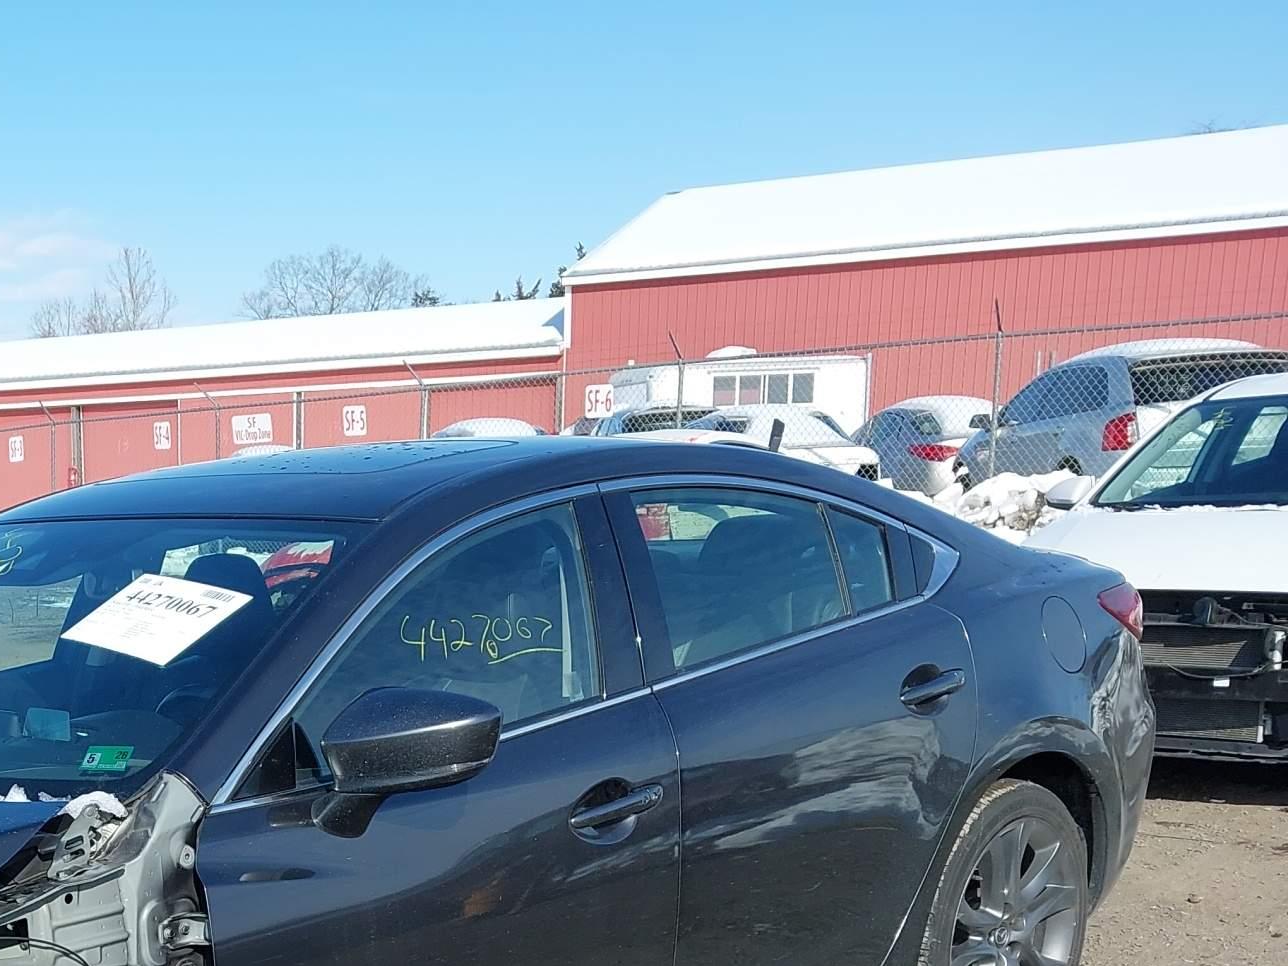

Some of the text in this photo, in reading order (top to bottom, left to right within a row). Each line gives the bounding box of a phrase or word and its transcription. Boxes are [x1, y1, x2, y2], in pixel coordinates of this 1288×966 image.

[587, 389, 612, 412] SF-6
[344, 410, 365, 432] SF-5
[155, 425, 170, 445] SF-4
[258, 428, 271, 440] Zone
[10, 440, 23, 458] SF-3
[126, 590, 218, 618] 44270067
